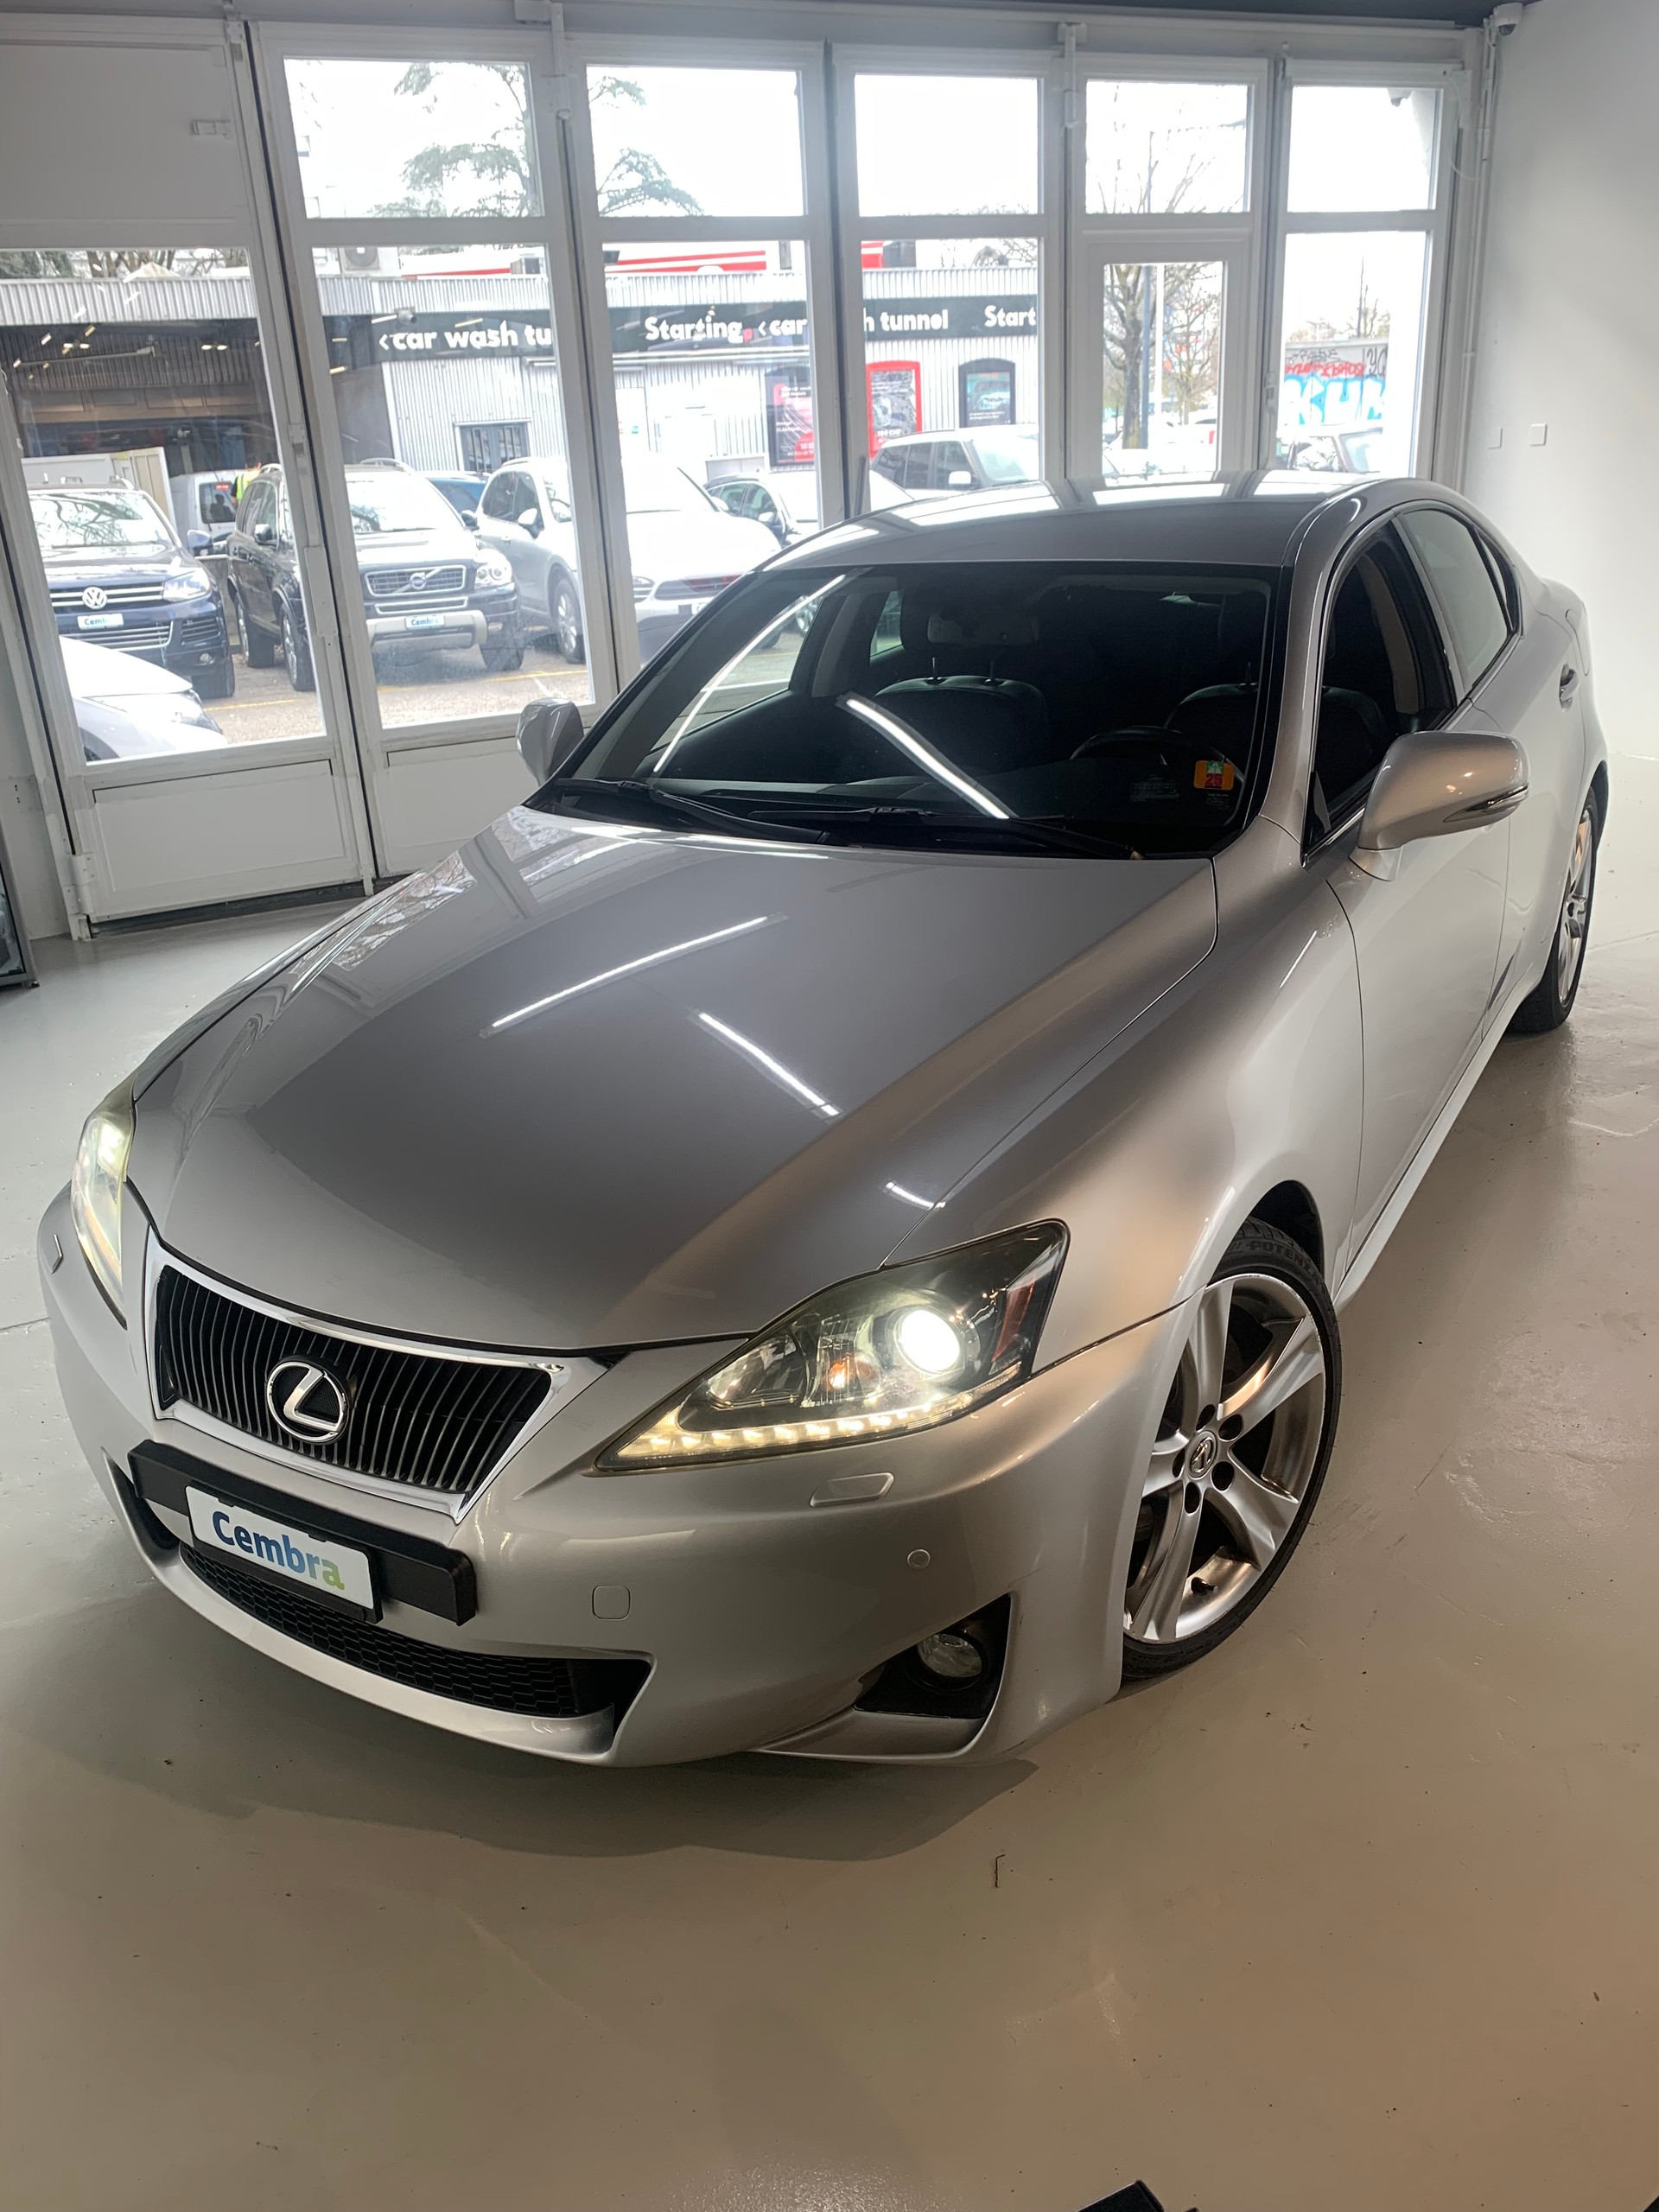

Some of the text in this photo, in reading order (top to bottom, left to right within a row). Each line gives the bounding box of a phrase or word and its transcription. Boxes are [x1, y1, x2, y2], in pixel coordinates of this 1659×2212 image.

[769, 318, 809, 337] car
[880, 308, 949, 332] tunnel
[983, 304, 1037, 327] Start
[391, 331, 437, 350] car
[444, 320, 518, 350] wash
[644, 315, 744, 344] Starting
[212, 1510, 346, 1591] Cembra
